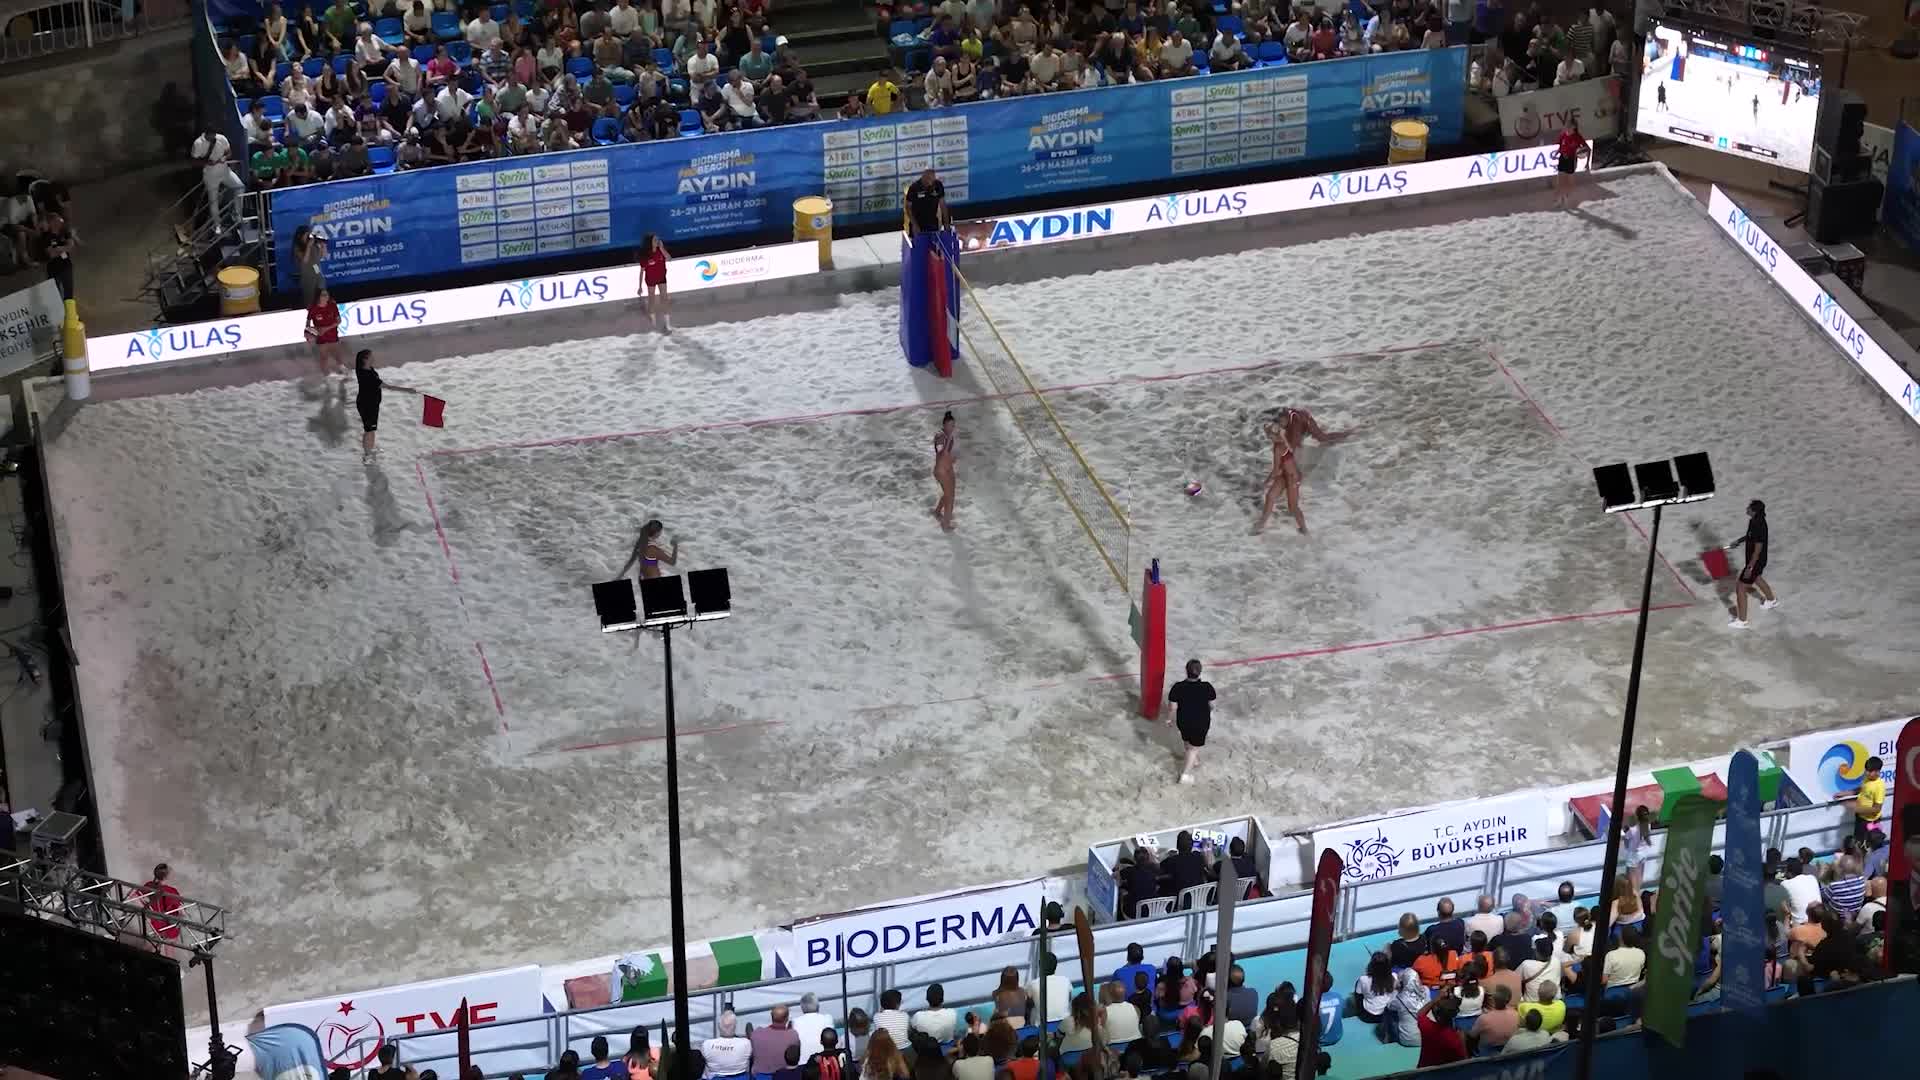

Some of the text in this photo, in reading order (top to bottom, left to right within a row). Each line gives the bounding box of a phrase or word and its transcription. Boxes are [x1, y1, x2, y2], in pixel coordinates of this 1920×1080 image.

[1360, 89, 1431, 112] AYDIN
[1028, 128, 1103, 151] AYDIN
[691, 149, 740, 167] BIODERMA
[498, 170, 528, 185] Sprite
[678, 171, 755, 194] AYDIN
[323, 193, 374, 212] BIODERMA
[311, 216, 392, 240] AYDIN
[461, 210, 493, 224] Sprite
[990, 208, 1112, 246] AYDIN
[0, 306, 29, 326] YDIN
[1193, 831, 1201, 841] 5
[1434, 816, 1506, 839] T.C. AYDIN
[1412, 826, 1527, 861] BÜYÜKŞEHİR
[807, 903, 1036, 967] BIODERMA
[1321, 1007, 1336, 1034] 7
